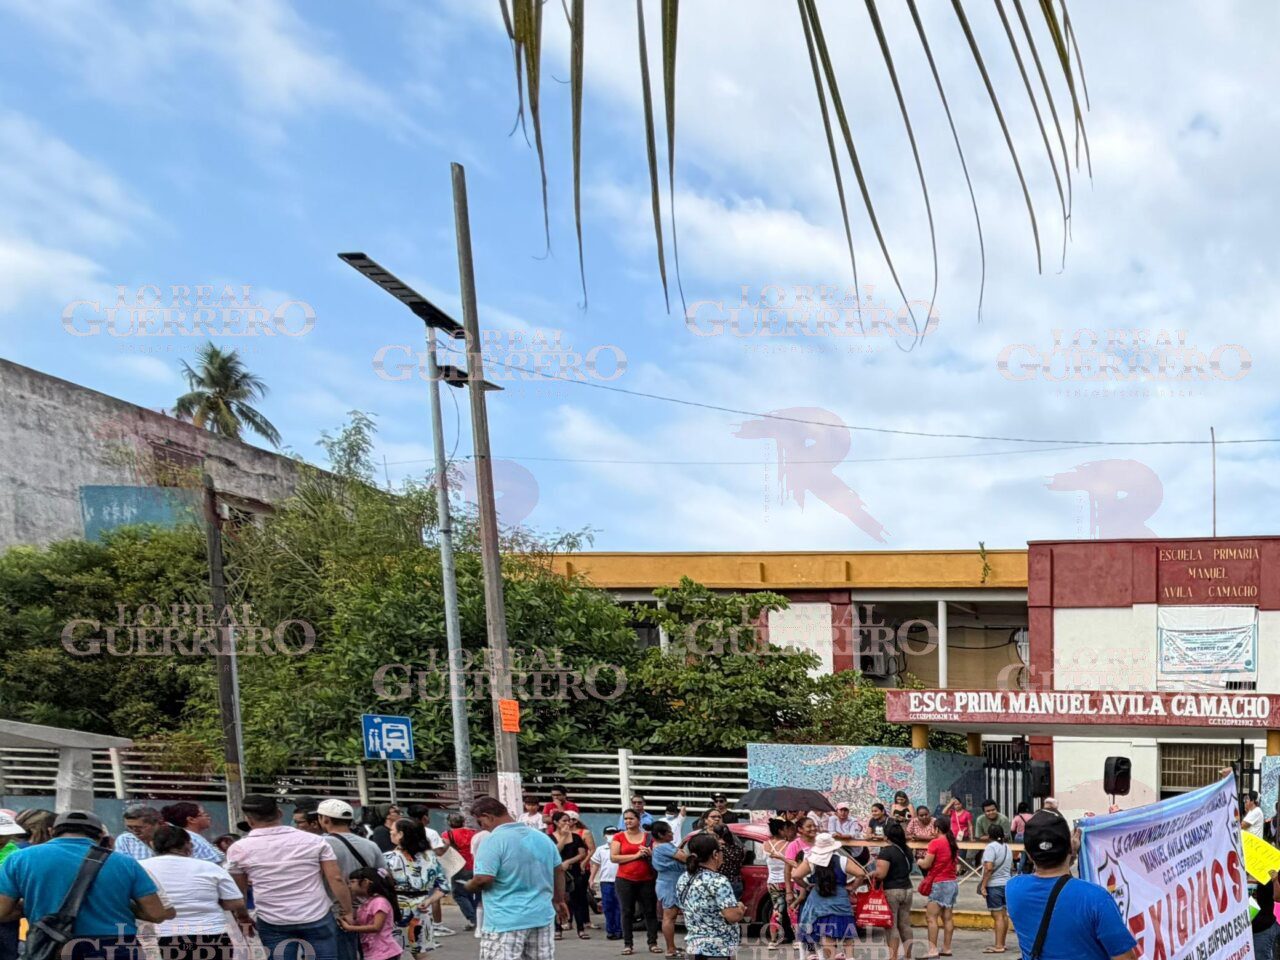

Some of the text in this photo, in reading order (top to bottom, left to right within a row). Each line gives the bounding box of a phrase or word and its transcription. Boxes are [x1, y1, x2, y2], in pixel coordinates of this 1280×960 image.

[1159, 547, 1260, 562] ESCUELA PRIMARIA
[1188, 566, 1228, 579] MANUEL
[1162, 585, 1258, 598] AVILA CAMACHO
[908, 692, 1270, 719] ESC. PRIM. MANUEL AVILA CAMACHO
[1124, 822, 1169, 853] COMUNIDAD
[1167, 836, 1185, 860] AVILA
[1208, 919, 1234, 957] EDIFICIO
